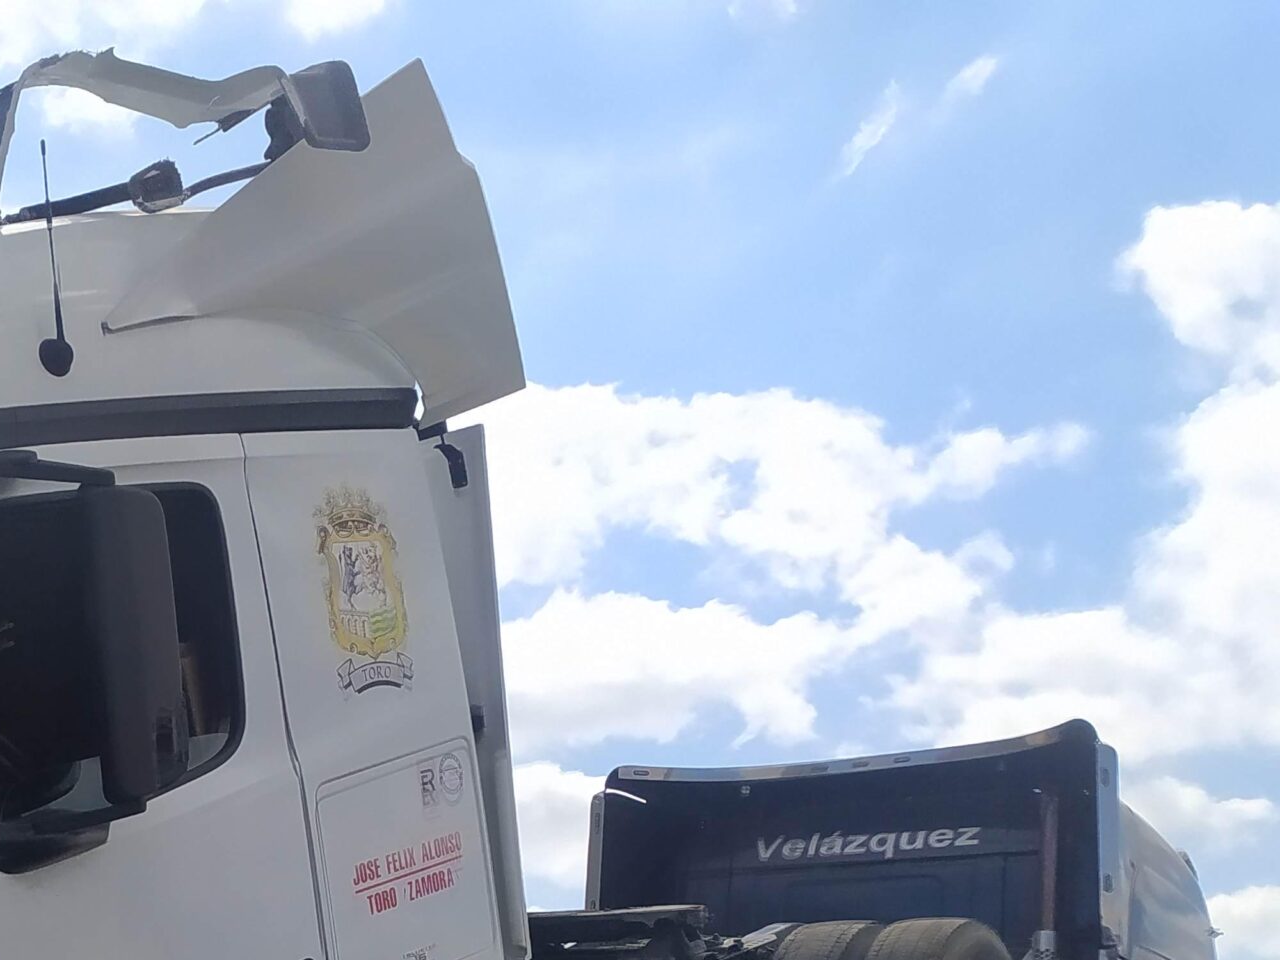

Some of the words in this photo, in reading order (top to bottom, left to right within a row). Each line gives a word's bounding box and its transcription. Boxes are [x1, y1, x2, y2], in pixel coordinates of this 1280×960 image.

[361, 665, 392, 682] TORO
[353, 858, 382, 886] JOSE
[386, 847, 416, 874] FELIX
[421, 831, 462, 863] ALONSO
[757, 826, 981, 862] Velázquez
[367, 887, 397, 915] TORO
